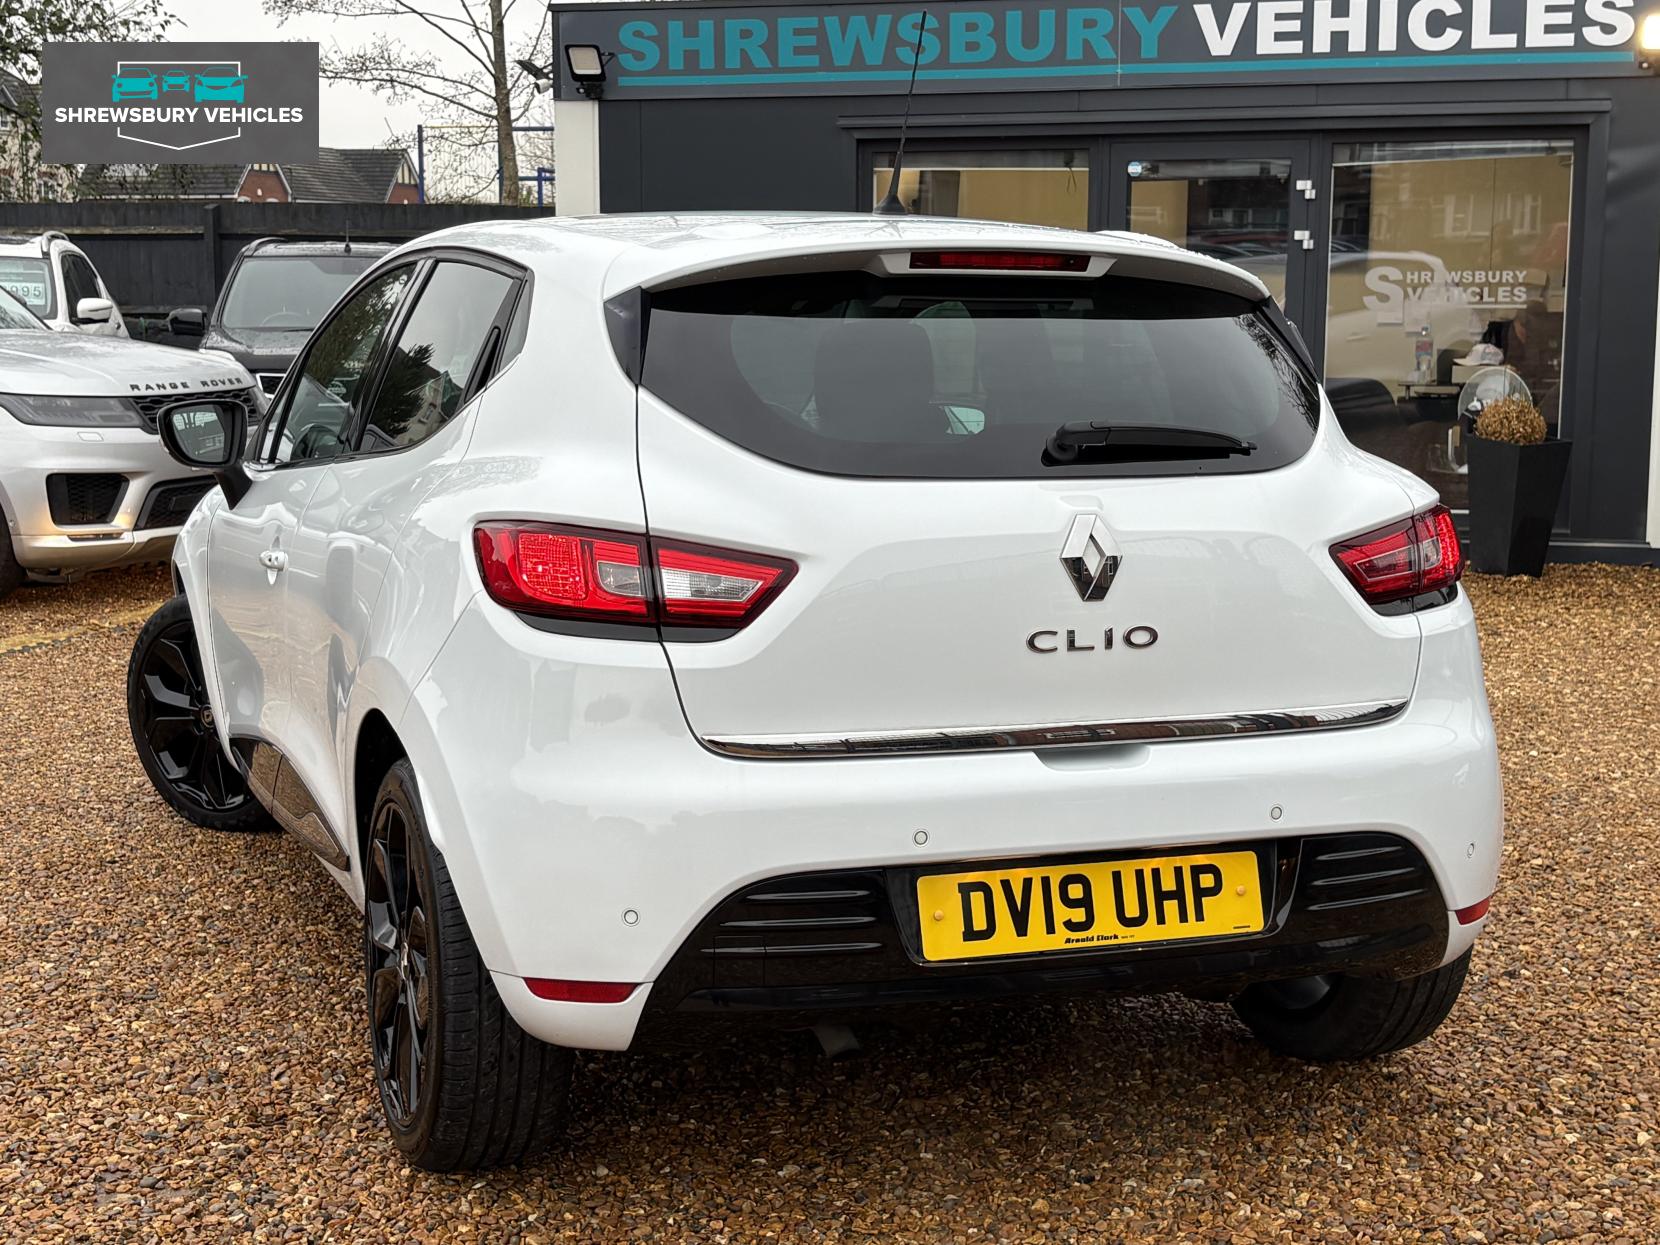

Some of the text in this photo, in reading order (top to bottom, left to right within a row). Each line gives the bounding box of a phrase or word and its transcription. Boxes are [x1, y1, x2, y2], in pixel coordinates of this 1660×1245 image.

[617, 0, 1635, 72] SHREWSBURY VEHICLES
[3, 285, 42, 298] 995
[129, 377, 243, 392] RANGE ROVER
[1025, 625, 1159, 655] CLIO
[957, 863, 1223, 942] DV19 UHP
